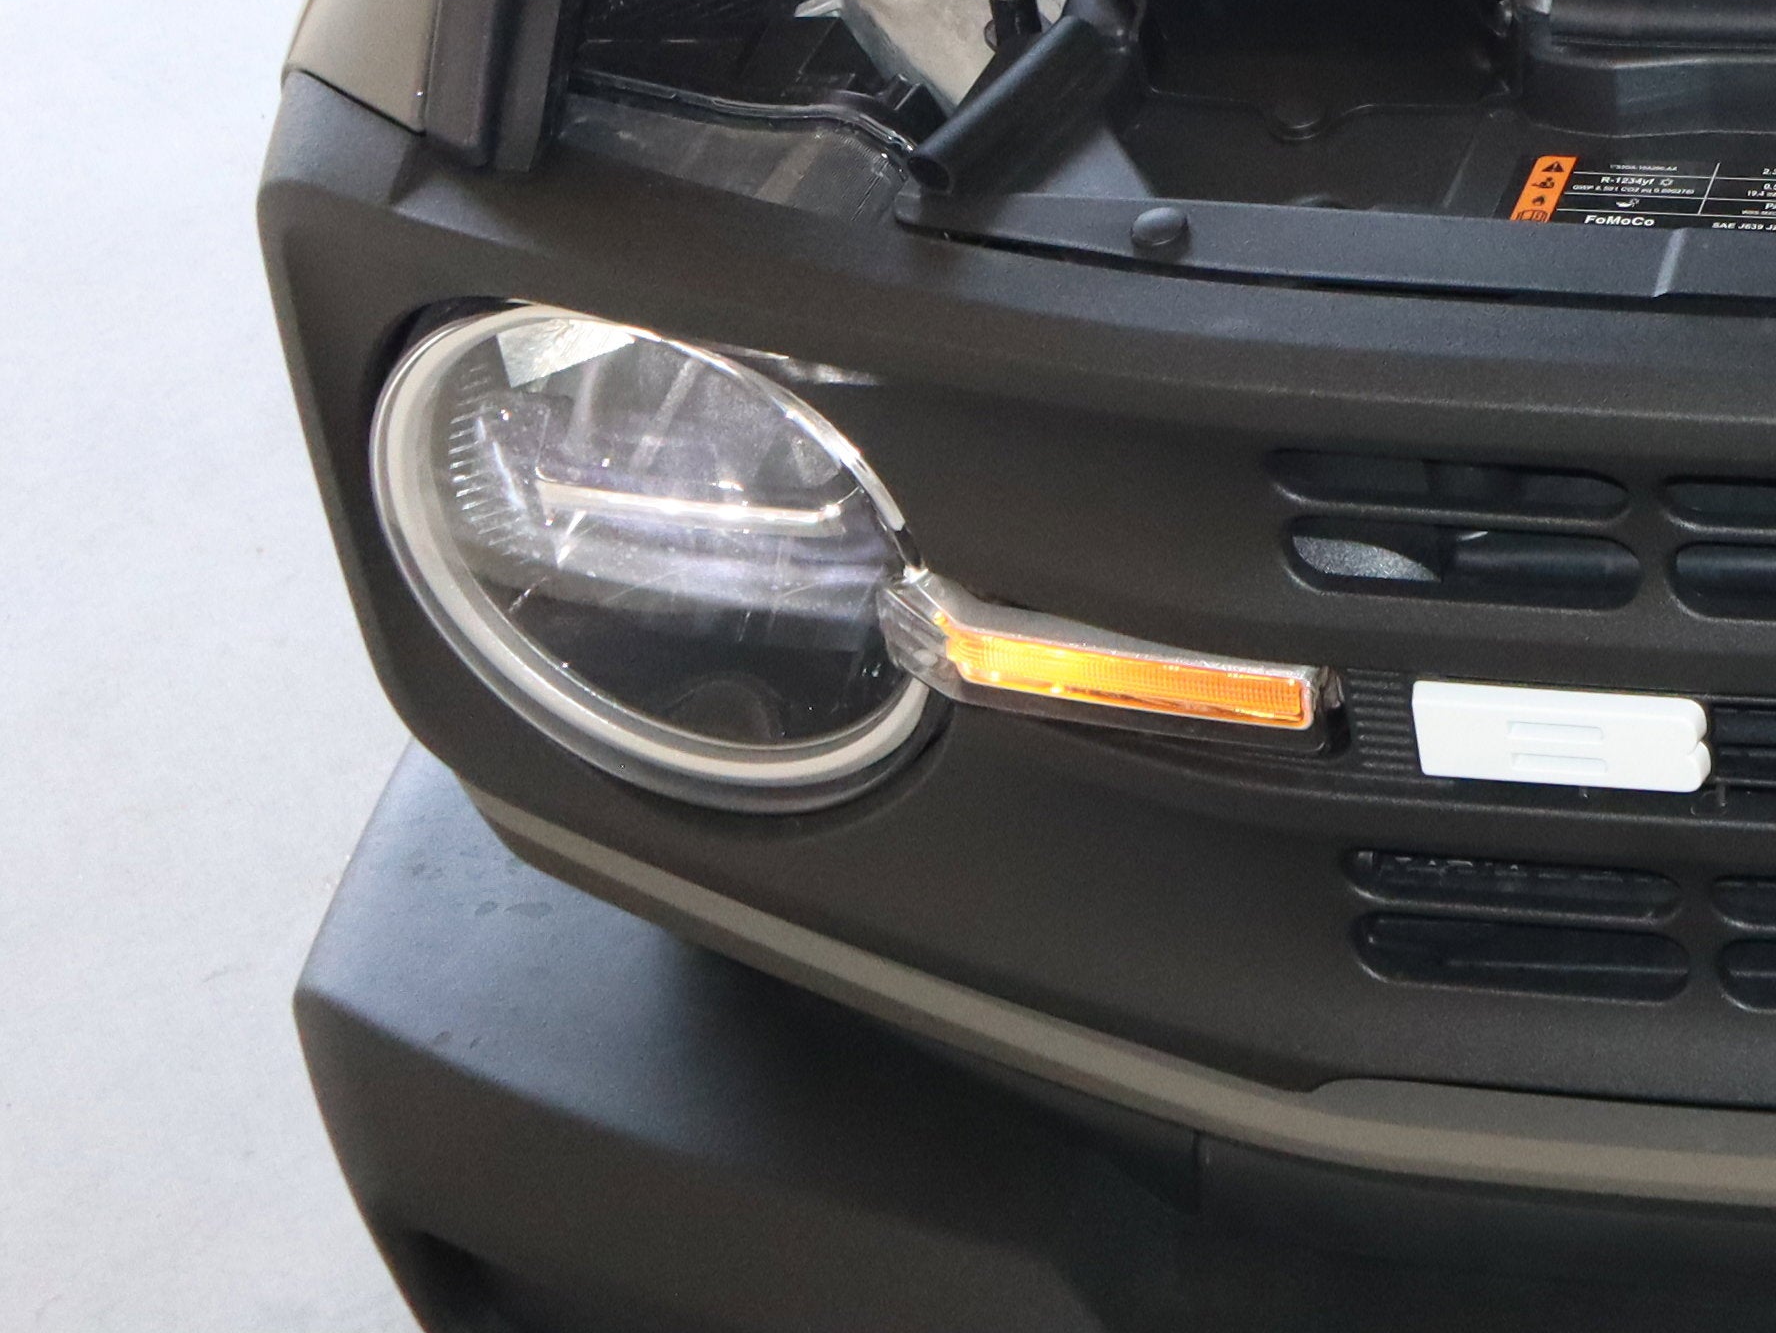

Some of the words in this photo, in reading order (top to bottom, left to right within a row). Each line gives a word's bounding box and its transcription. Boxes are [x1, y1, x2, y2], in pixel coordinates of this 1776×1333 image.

[1600, 176, 1656, 187] R-1234yf
[1584, 214, 1655, 227] FoMoCo
[1712, 222, 1736, 230] SAE
